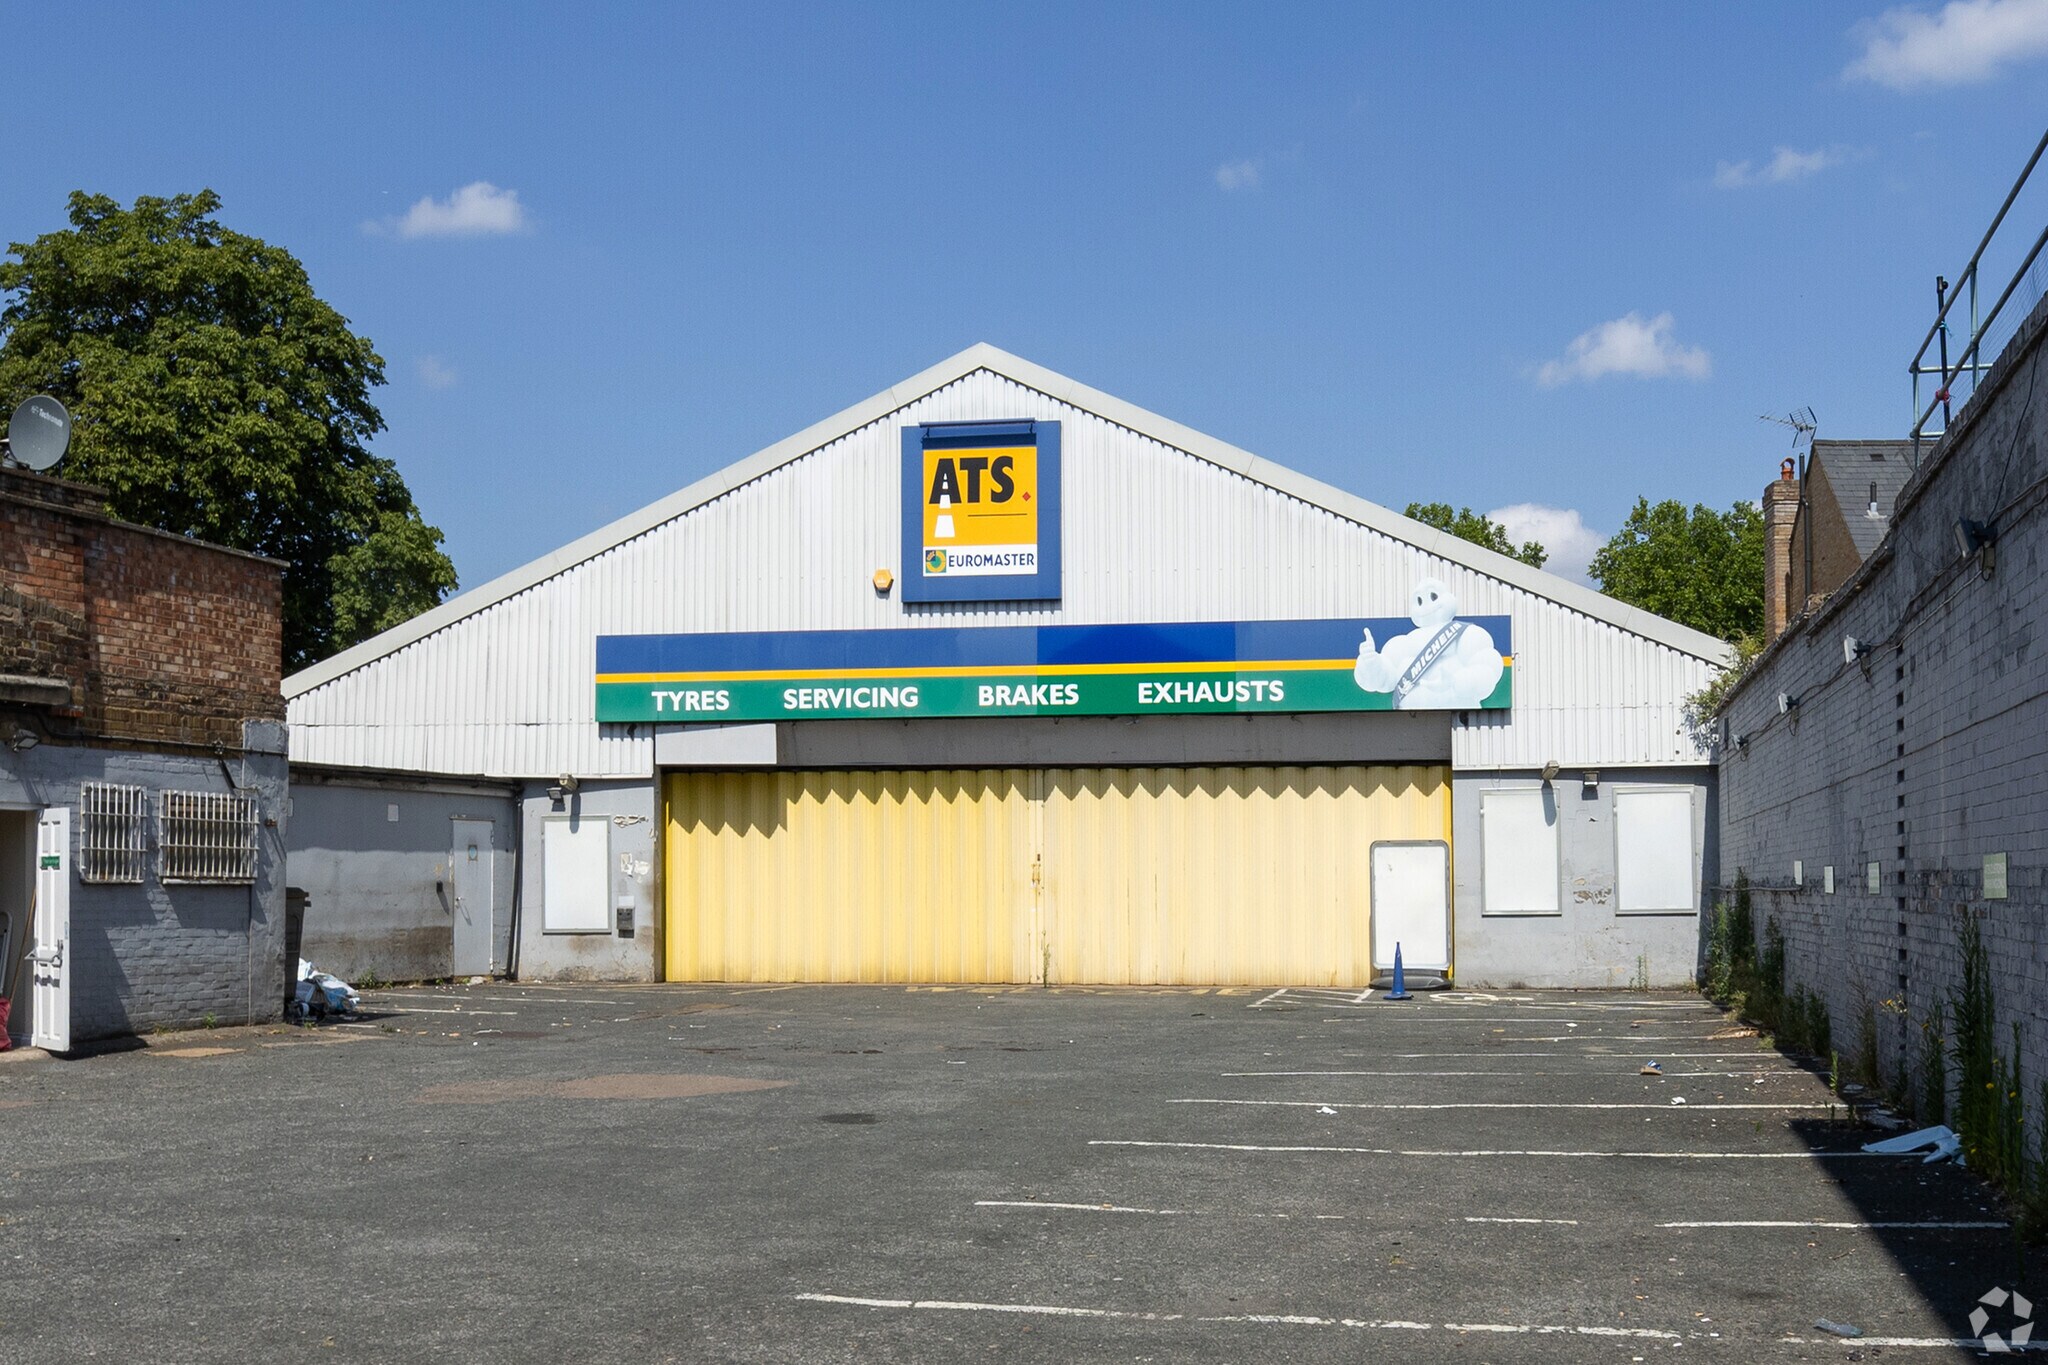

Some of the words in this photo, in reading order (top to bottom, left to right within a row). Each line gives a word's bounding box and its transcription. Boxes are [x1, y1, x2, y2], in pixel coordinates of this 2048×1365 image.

[928, 455, 1015, 504] ATS
[948, 553, 1035, 568] EUROMASTER
[1410, 622, 1462, 679] MICHELIN
[651, 689, 730, 712] TYRES
[783, 686, 919, 710] SERVICING
[978, 684, 1080, 707] BRAKES
[1138, 679, 1285, 704] EXHAUSTS
